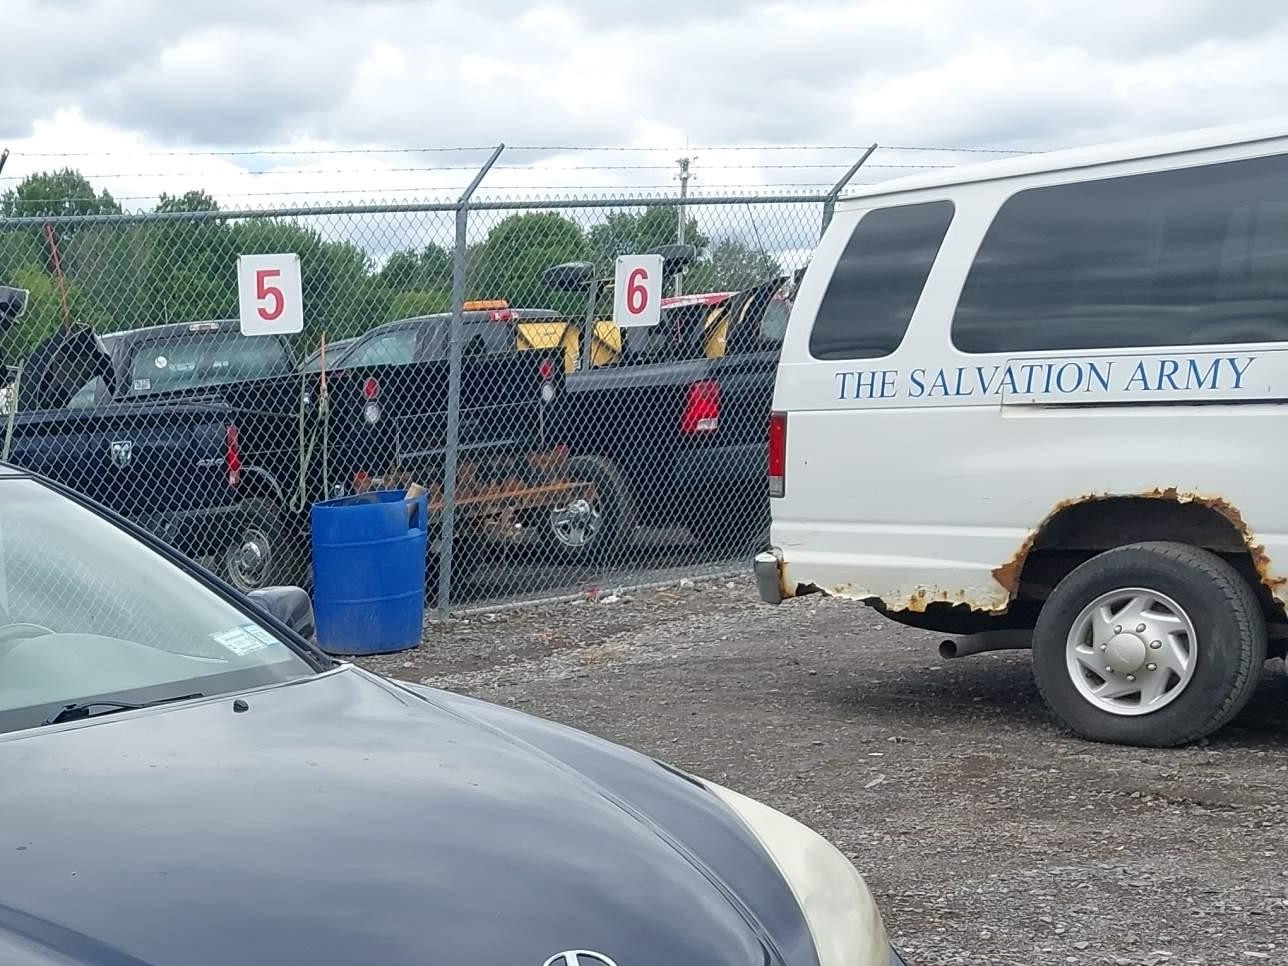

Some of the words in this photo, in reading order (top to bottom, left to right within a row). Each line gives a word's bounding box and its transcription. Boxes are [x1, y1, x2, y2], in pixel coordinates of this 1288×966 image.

[256, 269, 285, 320] 5
[626, 267, 649, 315] 6
[835, 370, 899, 400] THE
[907, 361, 1114, 397] SALVATION
[1123, 357, 1255, 392] ARMY
